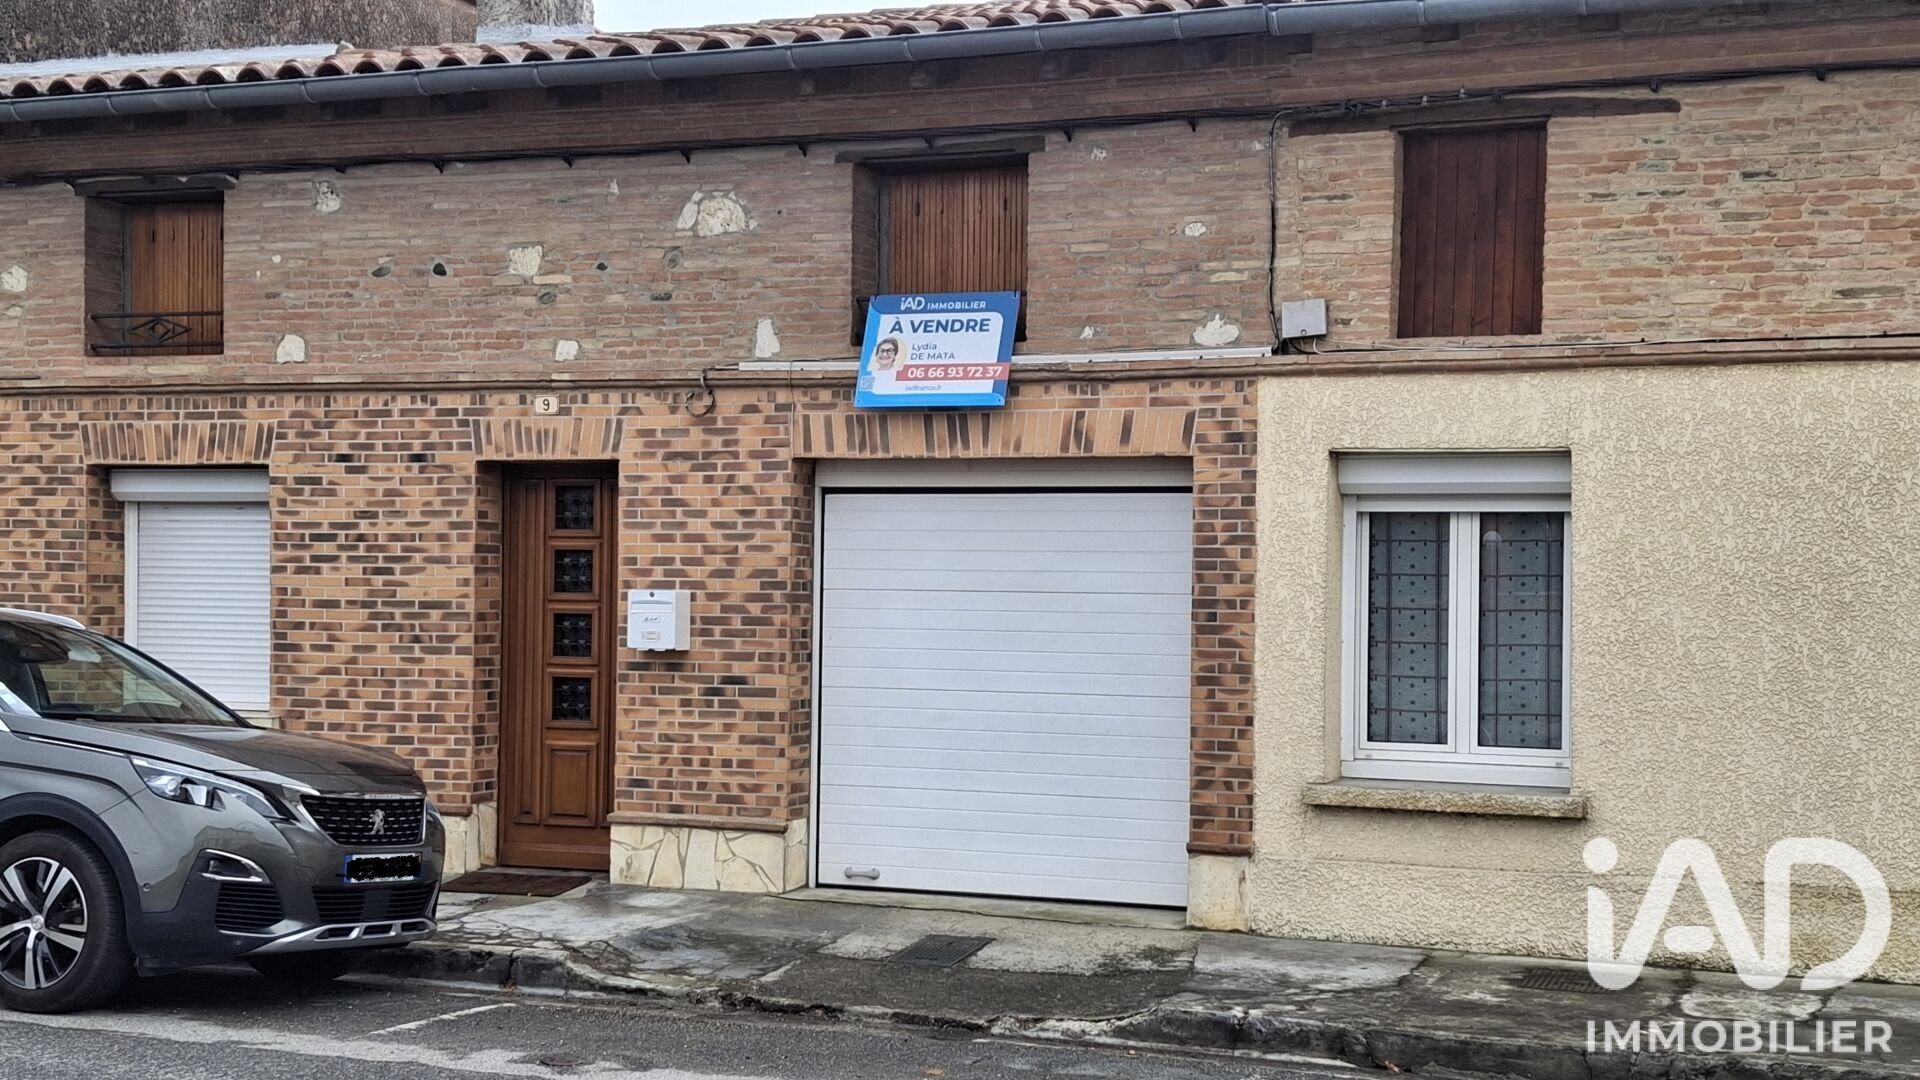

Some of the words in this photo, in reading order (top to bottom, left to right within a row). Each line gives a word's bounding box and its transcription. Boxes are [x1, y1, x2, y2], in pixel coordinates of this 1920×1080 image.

[900, 296, 925, 311] iAD
[926, 301, 986, 311] IMMOBILIER
[889, 316, 903, 334] À
[910, 318, 991, 333] VENDRE
[912, 343, 937, 352] Lydia
[910, 353, 925, 361] DE
[927, 352, 955, 361] MATA
[907, 367, 925, 378] 06
[928, 366, 945, 378] 66
[947, 366, 964, 377] 93
[967, 366, 983, 377] 72
[985, 366, 1003, 377] 37
[542, 398, 550, 411] 9
